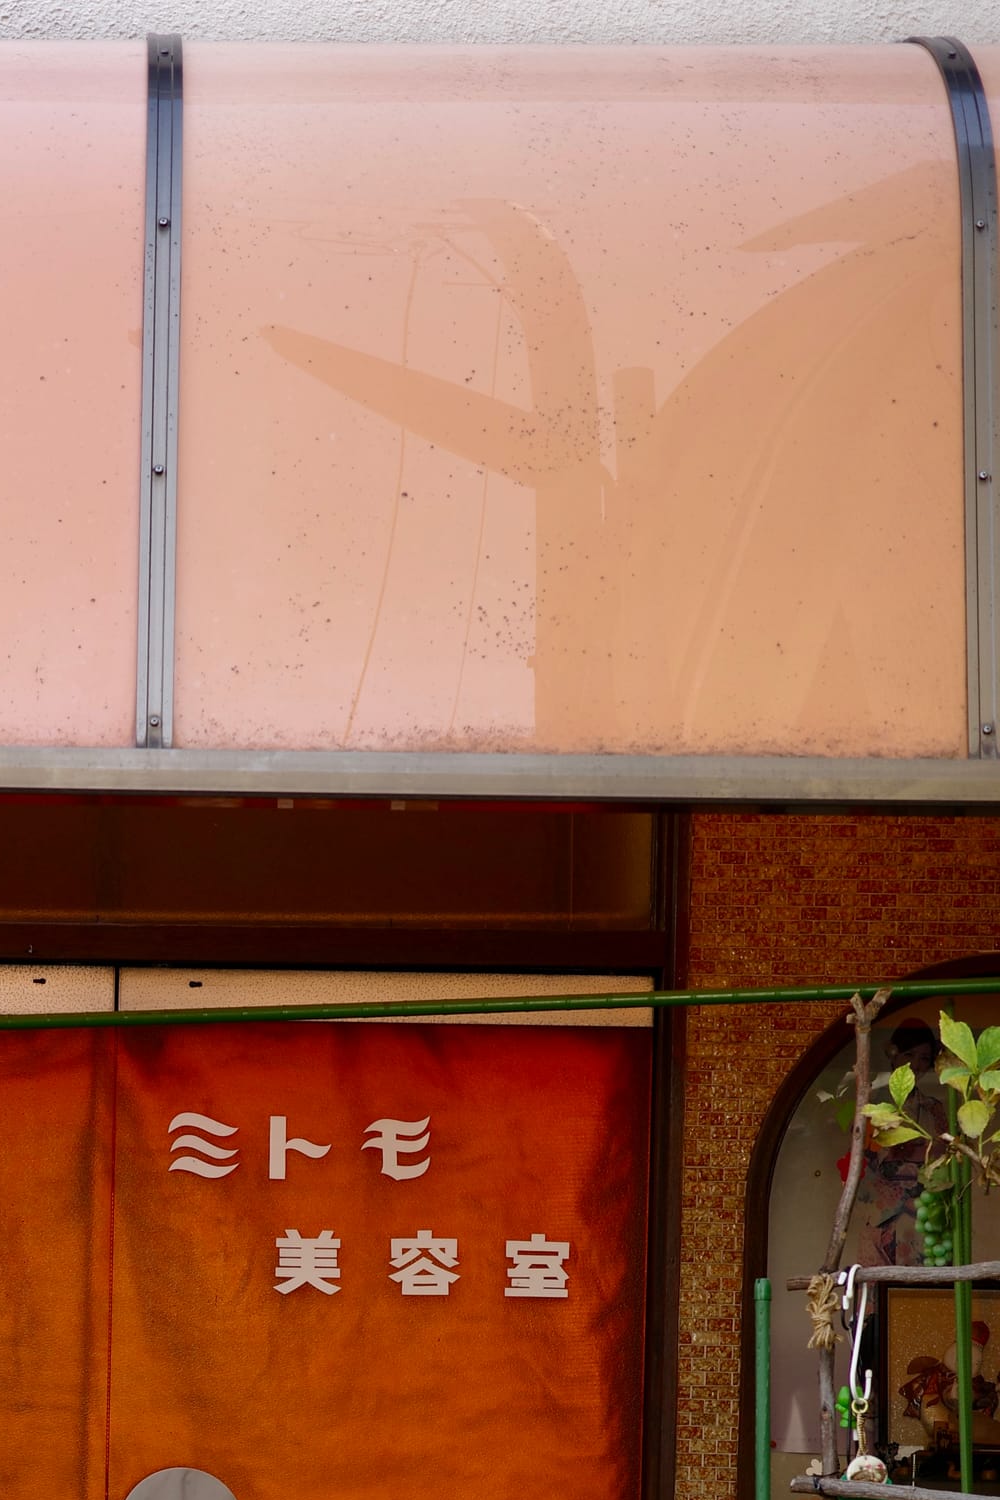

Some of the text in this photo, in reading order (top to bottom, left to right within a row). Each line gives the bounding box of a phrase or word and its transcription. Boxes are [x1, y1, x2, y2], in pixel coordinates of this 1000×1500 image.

[168, 1112, 431, 1181] ミトモ
[273, 1229, 570, 1298] 美容室
